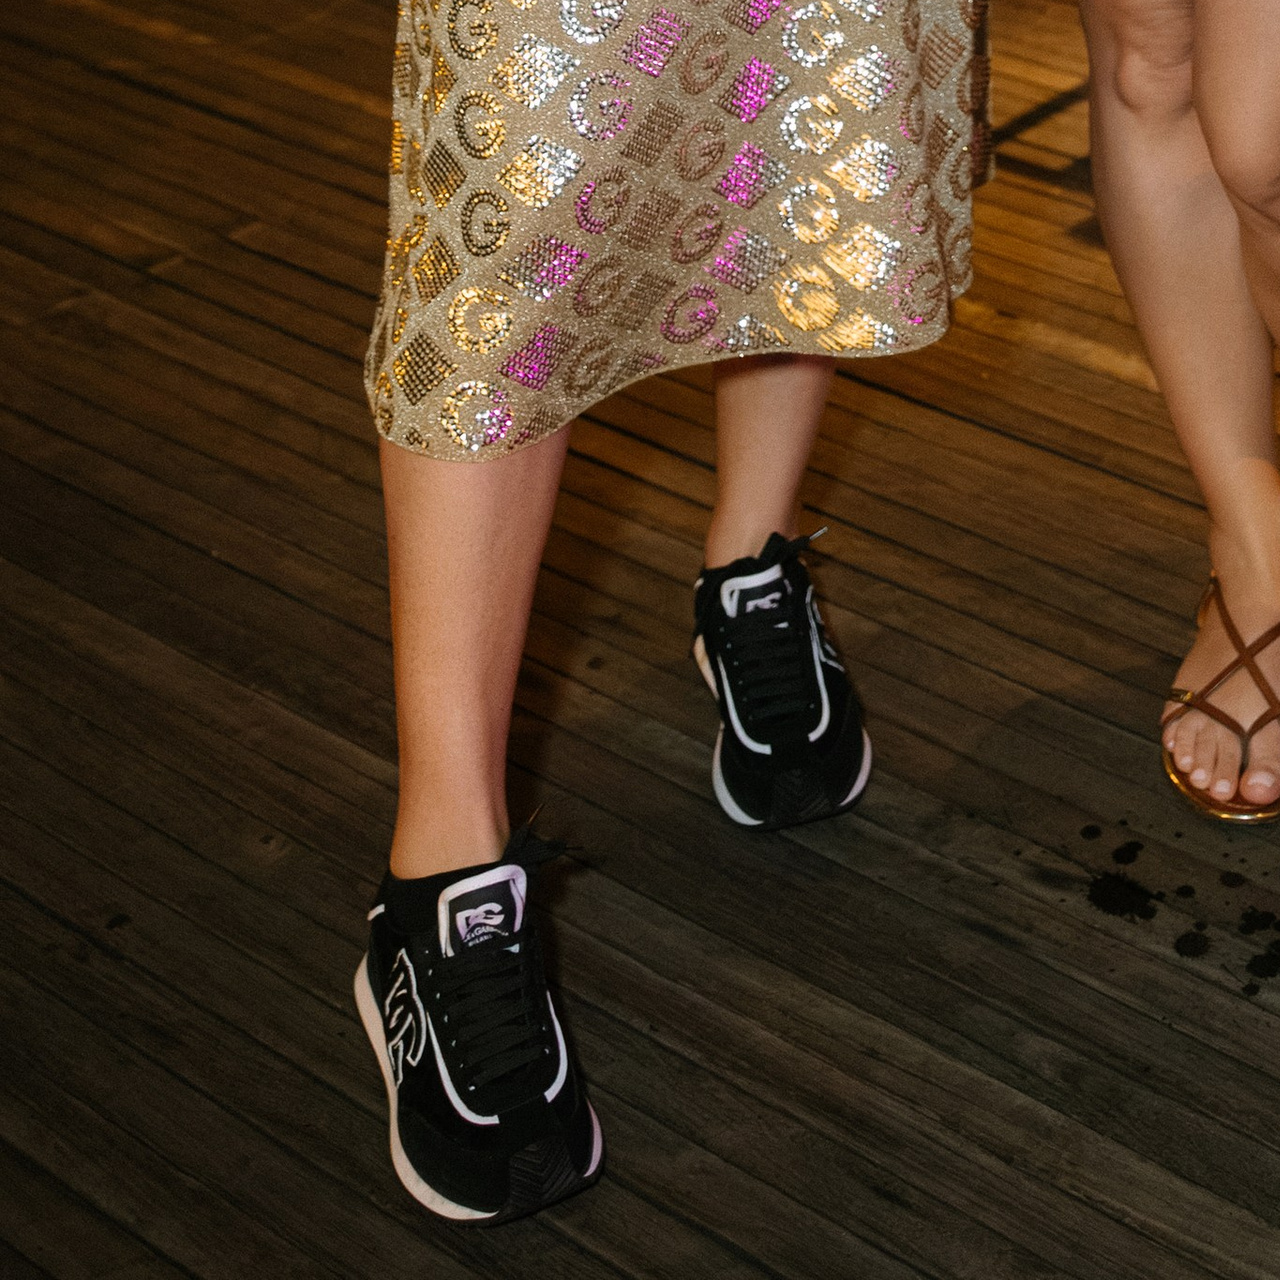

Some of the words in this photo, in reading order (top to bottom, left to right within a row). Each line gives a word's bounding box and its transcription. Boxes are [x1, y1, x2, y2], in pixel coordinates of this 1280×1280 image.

[679, 27, 730, 94] G
[781, 0, 845, 68] G
[454, 90, 506, 158] G
[568, 69, 633, 141] G
[779, 95, 843, 155] G
[675, 115, 725, 181] G
[461, 188, 510, 257] G
[574, 166, 630, 234] G
[671, 200, 723, 263] G
[777, 176, 840, 244] G
[448, 287, 512, 354] G
[661, 282, 720, 344] G
[773, 263, 840, 331] G
[440, 381, 514, 451] G
